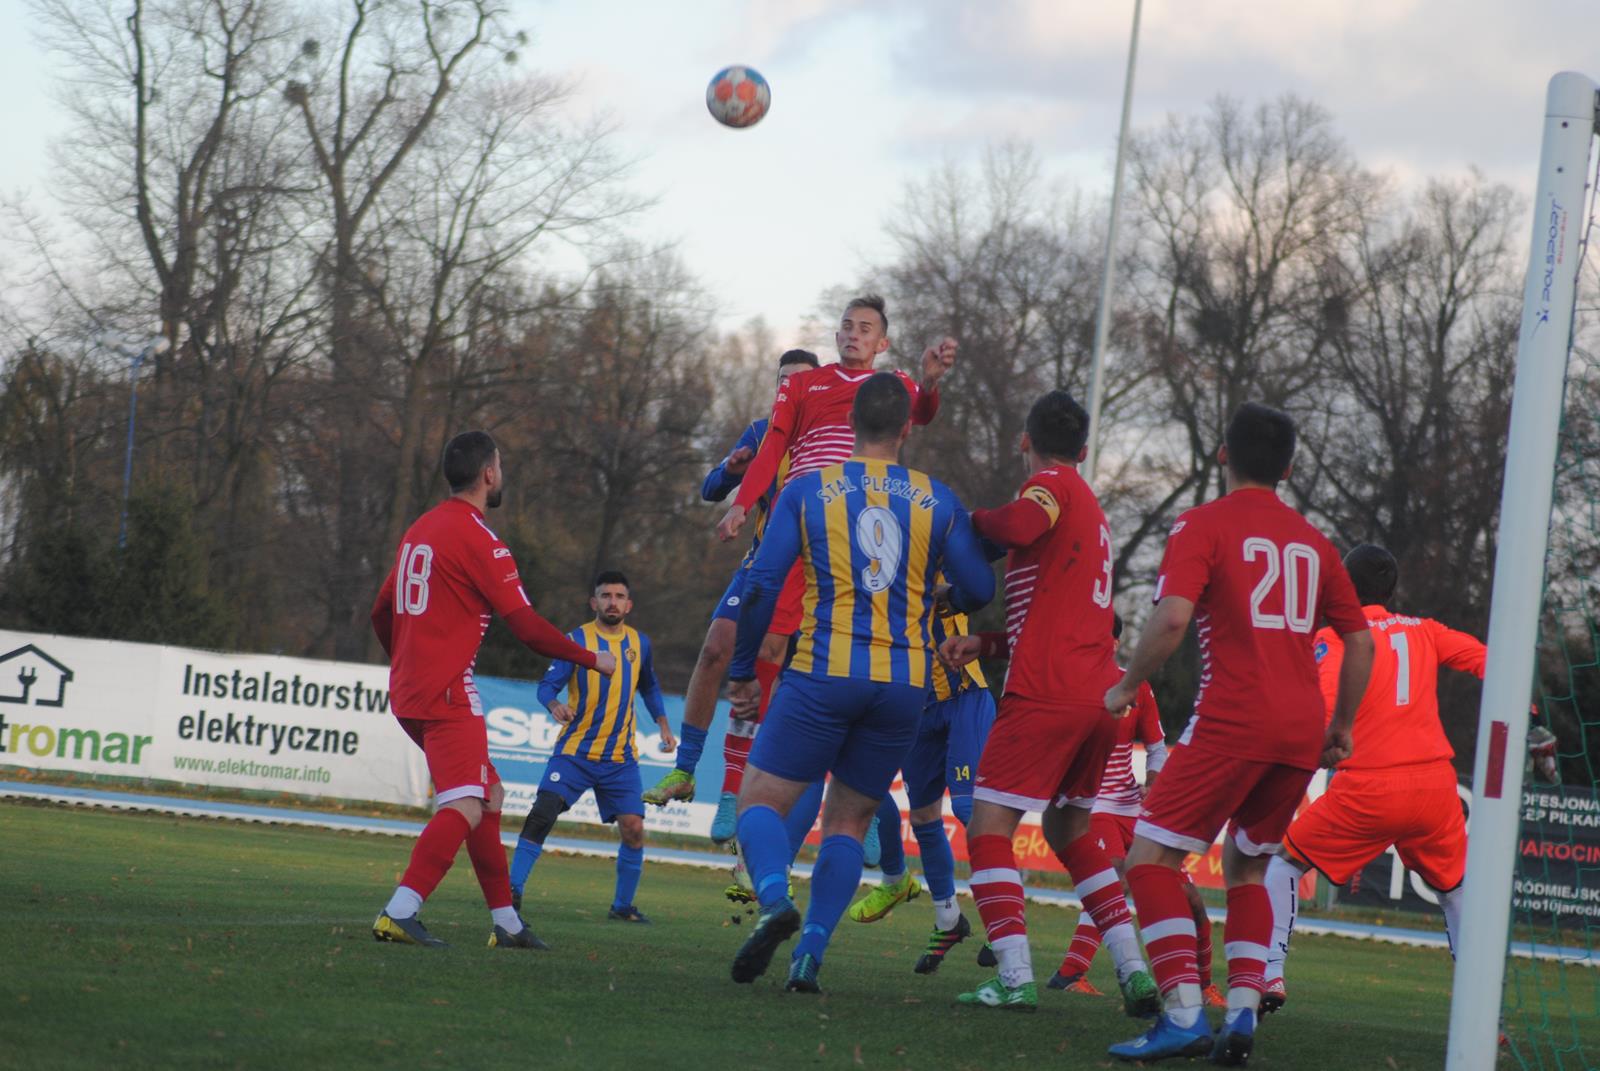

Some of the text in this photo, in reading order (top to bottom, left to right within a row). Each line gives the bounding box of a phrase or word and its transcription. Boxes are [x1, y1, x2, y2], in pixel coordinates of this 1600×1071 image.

[816, 474, 940, 511] STAL PLESZEW
[856, 506, 903, 592] 9
[1092, 523, 1113, 609] 3
[396, 543, 434, 616] 18
[1243, 536, 1320, 634] 20
[182, 664, 390, 714] Instalatorstw
[1389, 631, 1411, 706] 1
[178, 710, 360, 755] elektryczne
[173, 755, 331, 784] www.elektromar.info
[955, 764, 970, 781] 14
[1514, 877, 1600, 902] RÓDMIEJSK
